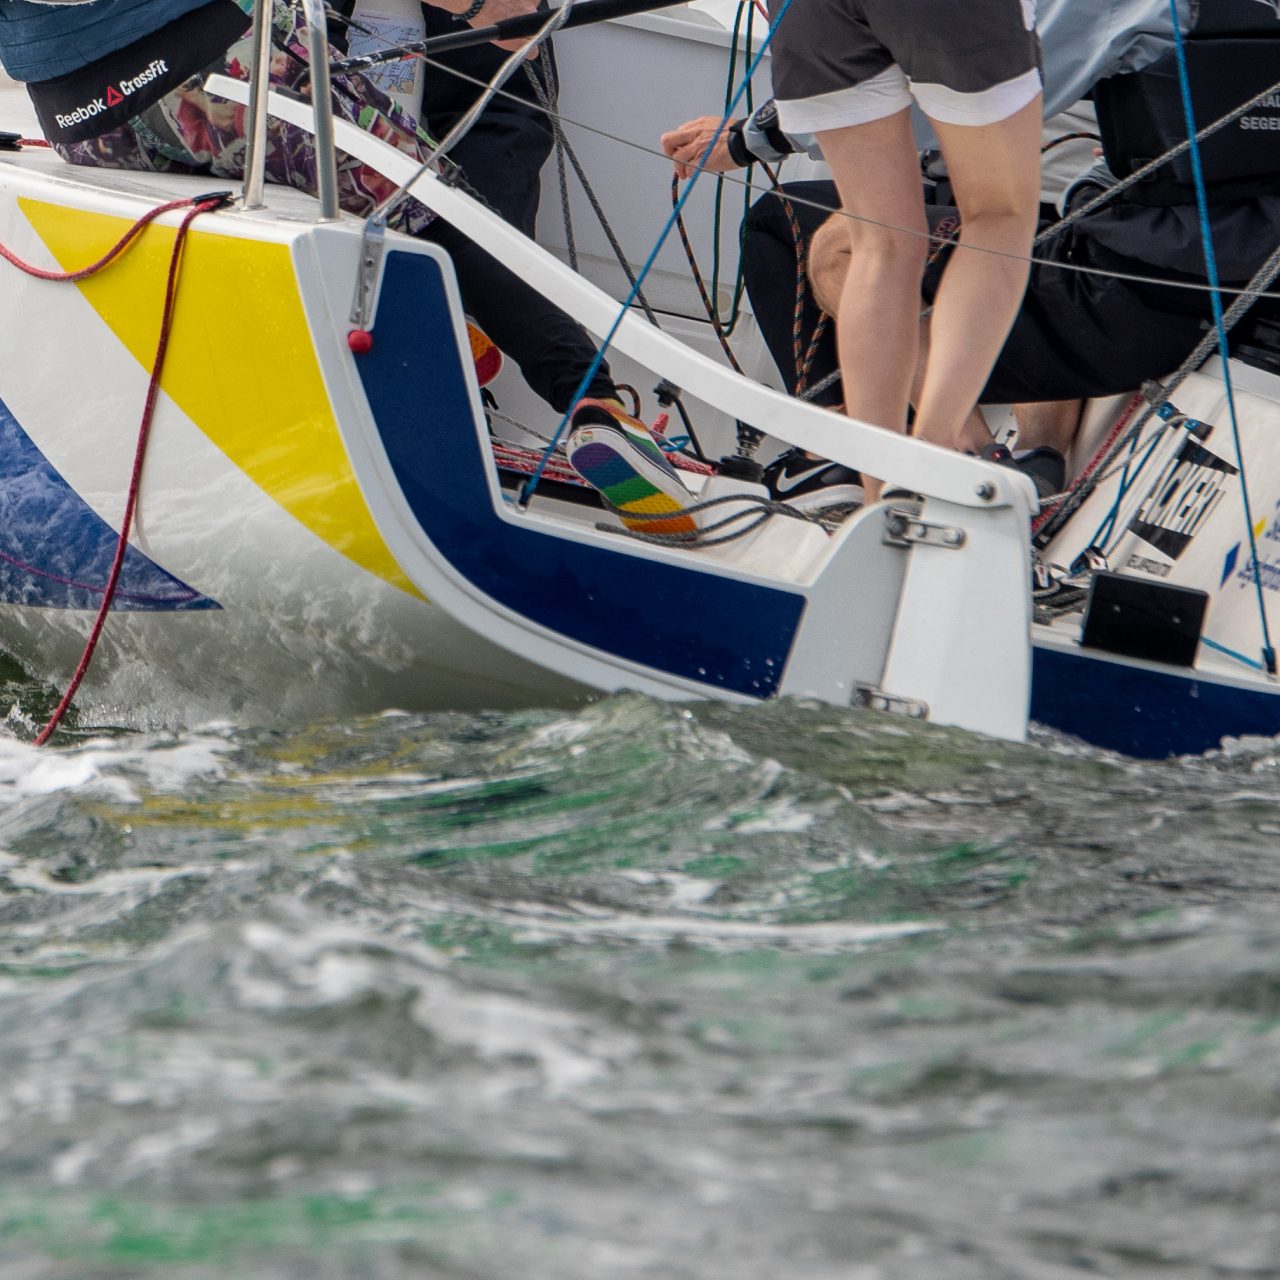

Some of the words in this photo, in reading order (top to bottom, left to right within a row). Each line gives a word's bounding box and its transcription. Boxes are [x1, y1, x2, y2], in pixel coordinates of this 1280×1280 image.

[55, 98, 107, 128] Reebok
[120, 59, 169, 96] CrossFit
[1240, 116, 1280, 130] SEGE
